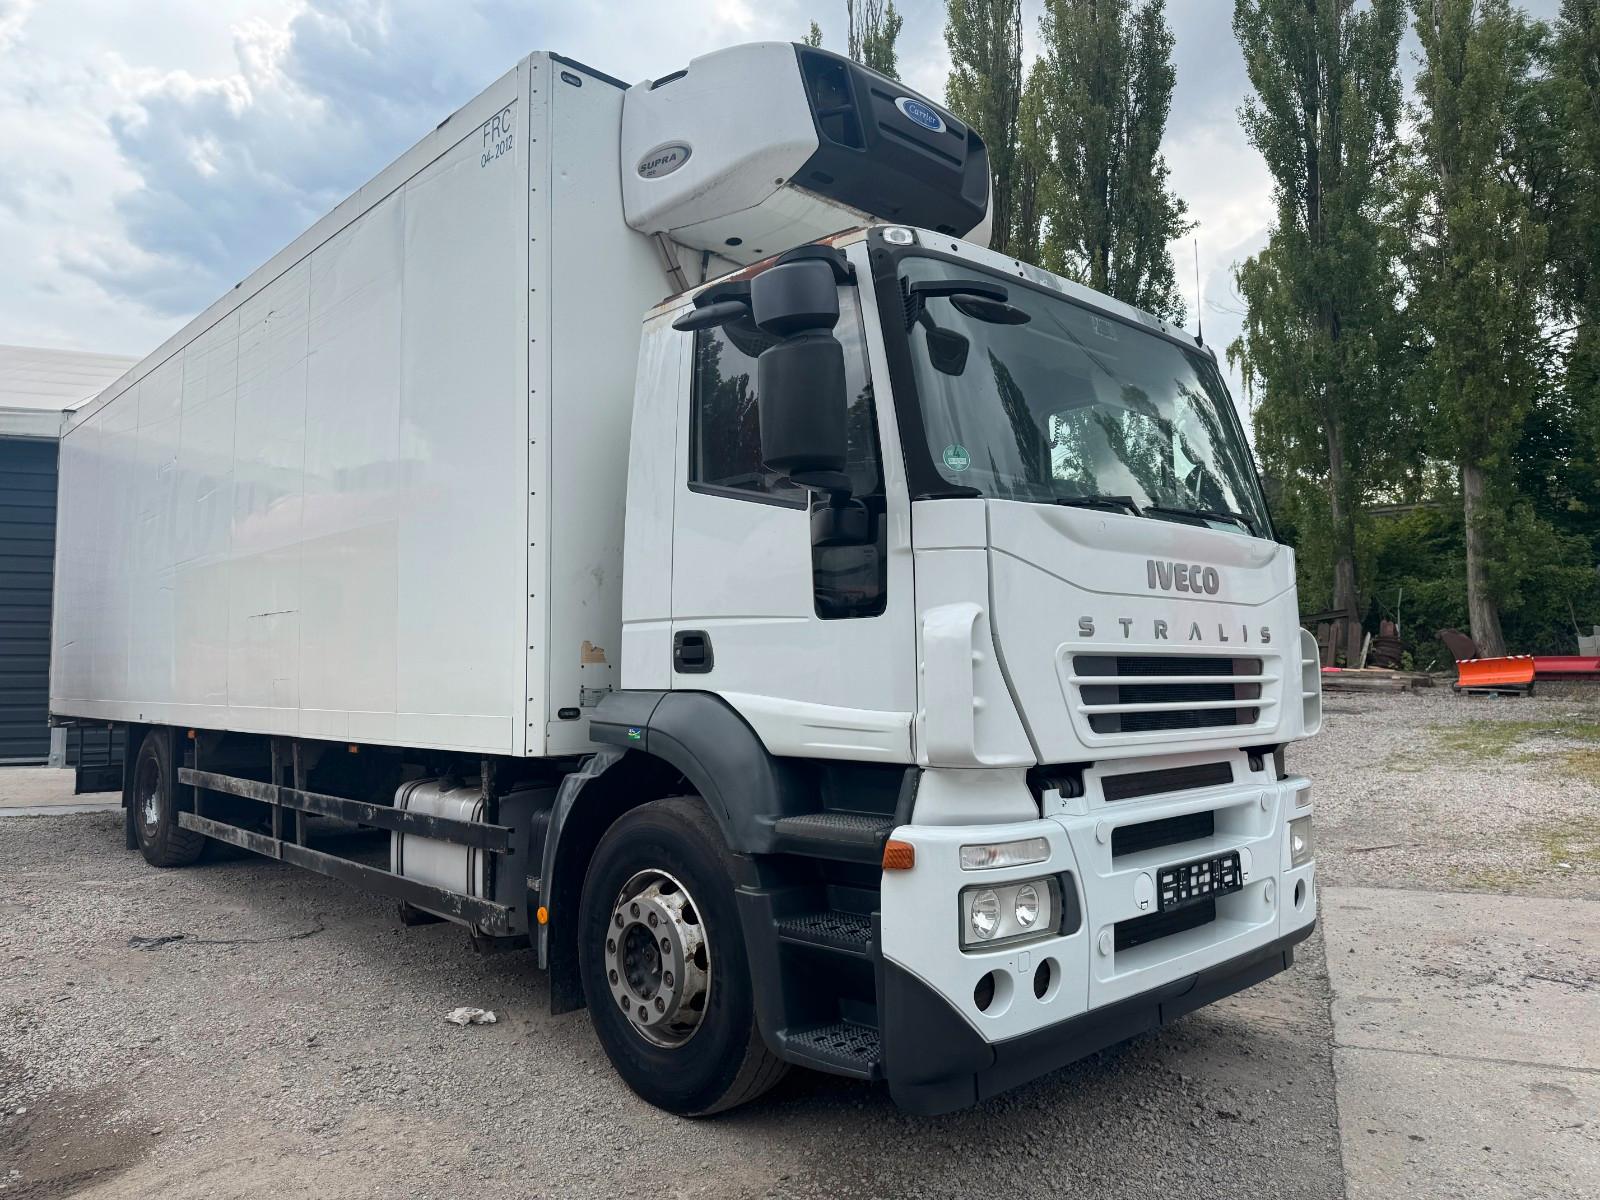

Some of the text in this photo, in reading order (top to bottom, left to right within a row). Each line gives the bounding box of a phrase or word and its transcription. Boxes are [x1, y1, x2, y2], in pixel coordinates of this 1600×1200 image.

[483, 108, 511, 148] FRC
[480, 134, 513, 169] 04-2012
[640, 152, 677, 173] SUPRA
[1146, 559, 1220, 595] IVECO
[1078, 616, 1271, 644] STRALIS
